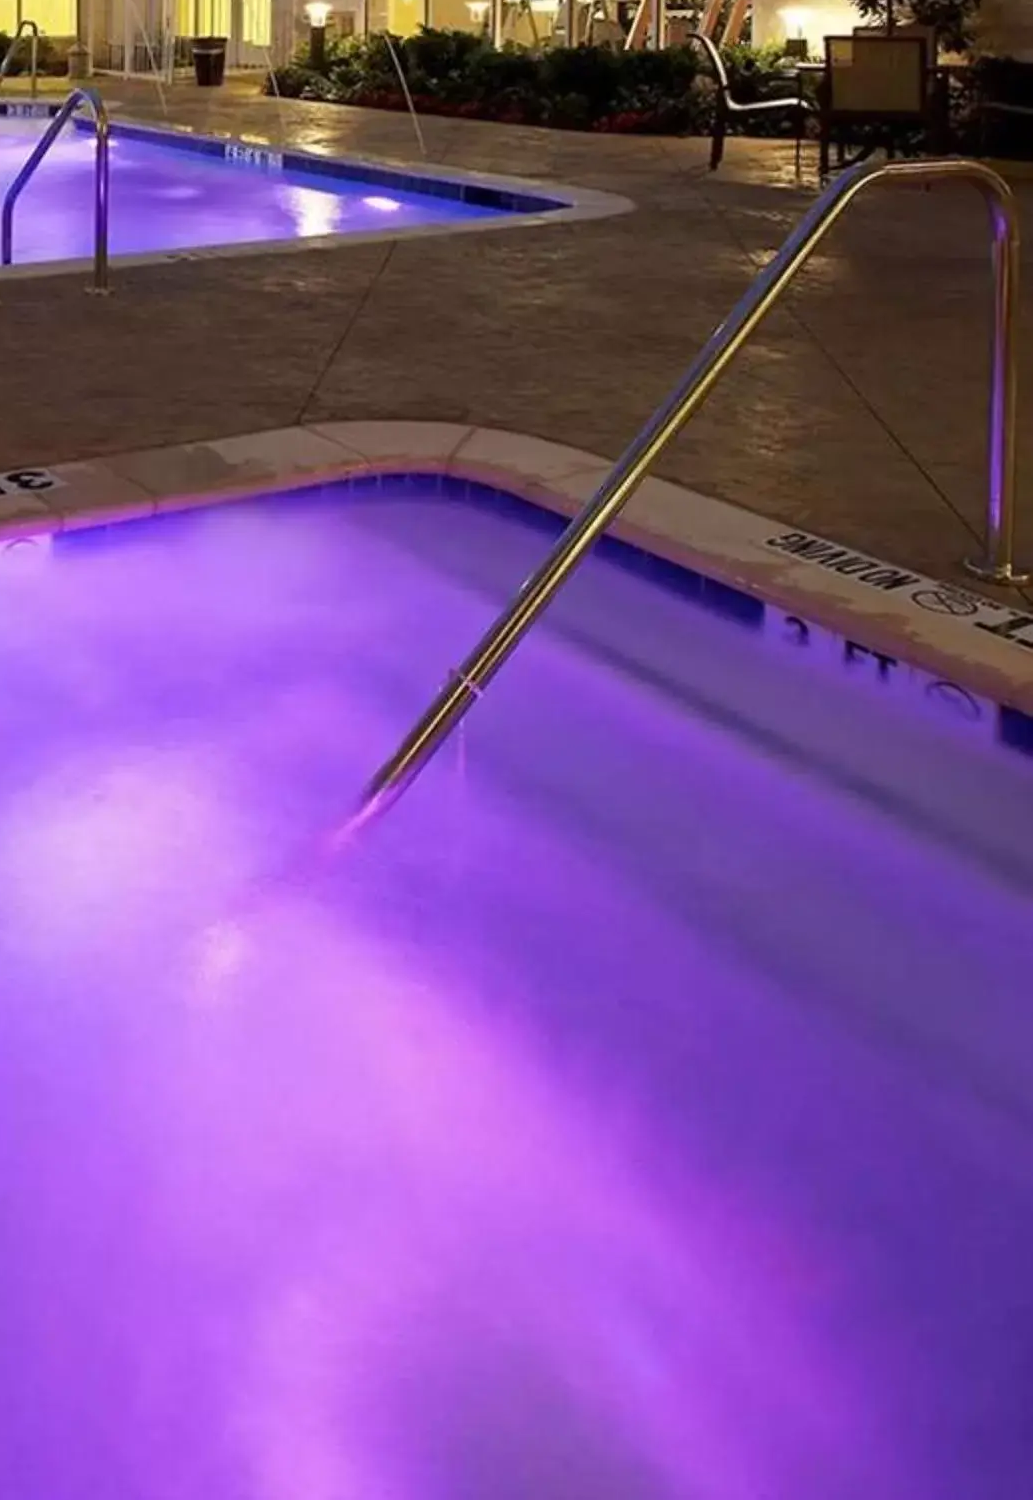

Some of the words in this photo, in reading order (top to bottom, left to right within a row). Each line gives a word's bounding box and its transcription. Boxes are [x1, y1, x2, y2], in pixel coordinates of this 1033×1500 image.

[7, 471, 54, 490] 3
[766, 532, 878, 576] DIVING
[858, 568, 921, 591] NO
